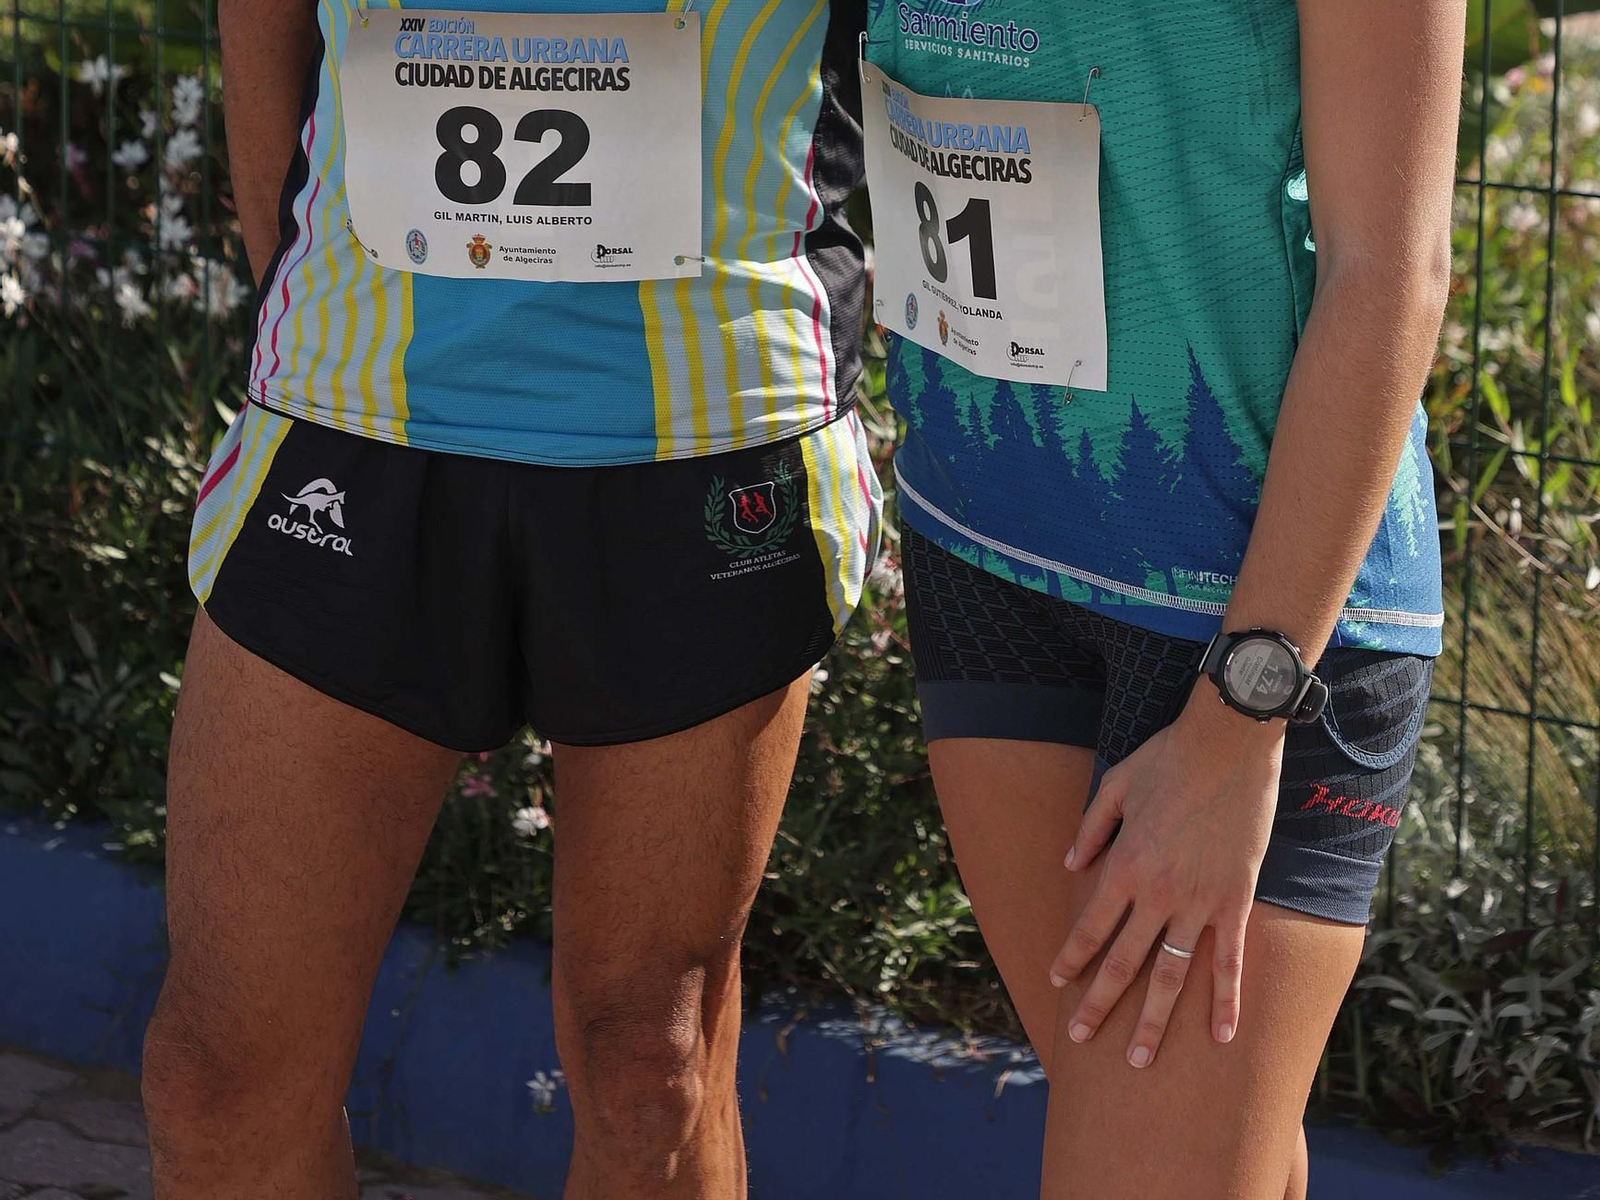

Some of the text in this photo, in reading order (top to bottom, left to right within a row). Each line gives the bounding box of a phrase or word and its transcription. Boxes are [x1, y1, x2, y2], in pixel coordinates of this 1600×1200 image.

[400, 17, 474, 34] XXIV EDICIÓN
[898, 2, 1040, 53] Sarmiento
[394, 33, 629, 64] CARRERA URBANA
[904, 39, 1031, 68] SERVICIOS SANITARIOS
[395, 62, 630, 91] CIUDAD DE ALGECIRAS
[926, 120, 1031, 154] URBANA
[434, 106, 592, 207] 82
[890, 123, 1032, 184] CIUDAD DE ALGECIRAS
[434, 211, 593, 226] GIL MARTIN, LUIS ALBERTO
[499, 245, 557, 256] Ayuntamiento
[915, 181, 998, 300] 81
[515, 255, 553, 264] Algeciras
[959, 303, 1003, 320] YOLANDA
[267, 514, 354, 556] austral
[710, 565, 761, 580] VETERANOS
[729, 550, 787, 569] CLUB ATLETAS
